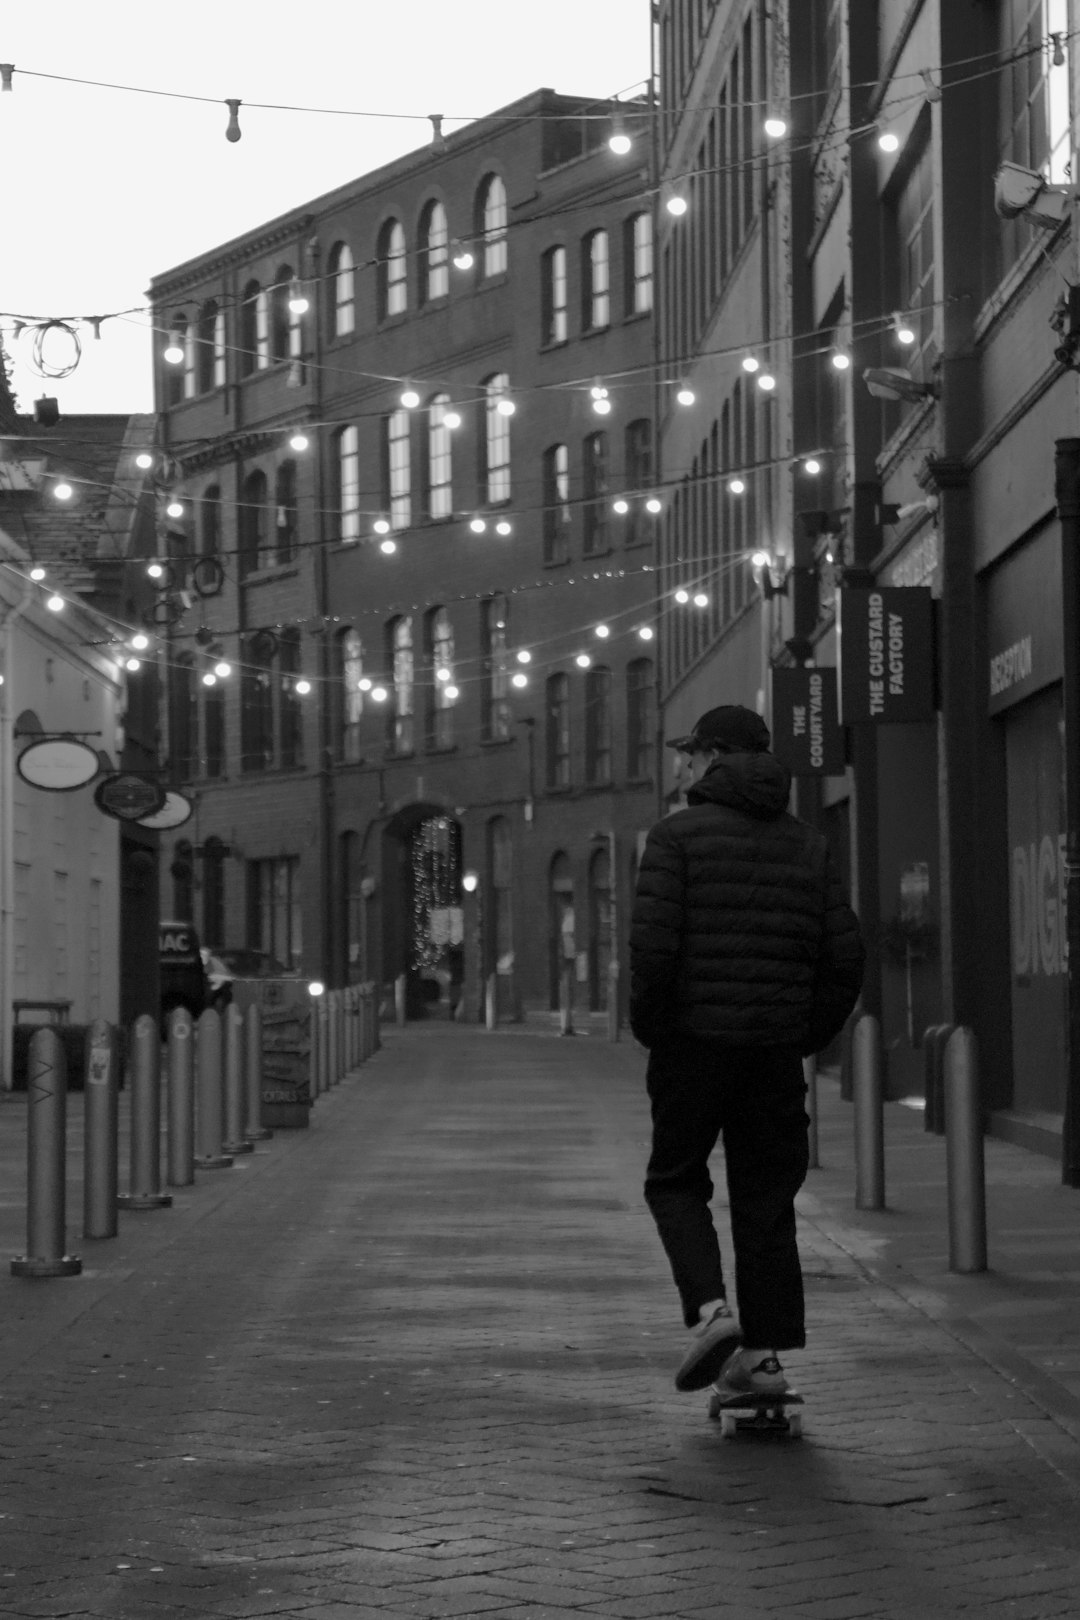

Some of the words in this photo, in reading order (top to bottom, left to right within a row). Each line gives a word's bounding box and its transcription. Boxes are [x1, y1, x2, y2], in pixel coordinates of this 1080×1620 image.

[868, 592, 885, 677] CUSTARD
[889, 612, 904, 695] FACTORY
[793, 705, 806, 737] THE
[809, 673, 824, 768] COURTYARD
[869, 680, 885, 716] THE
